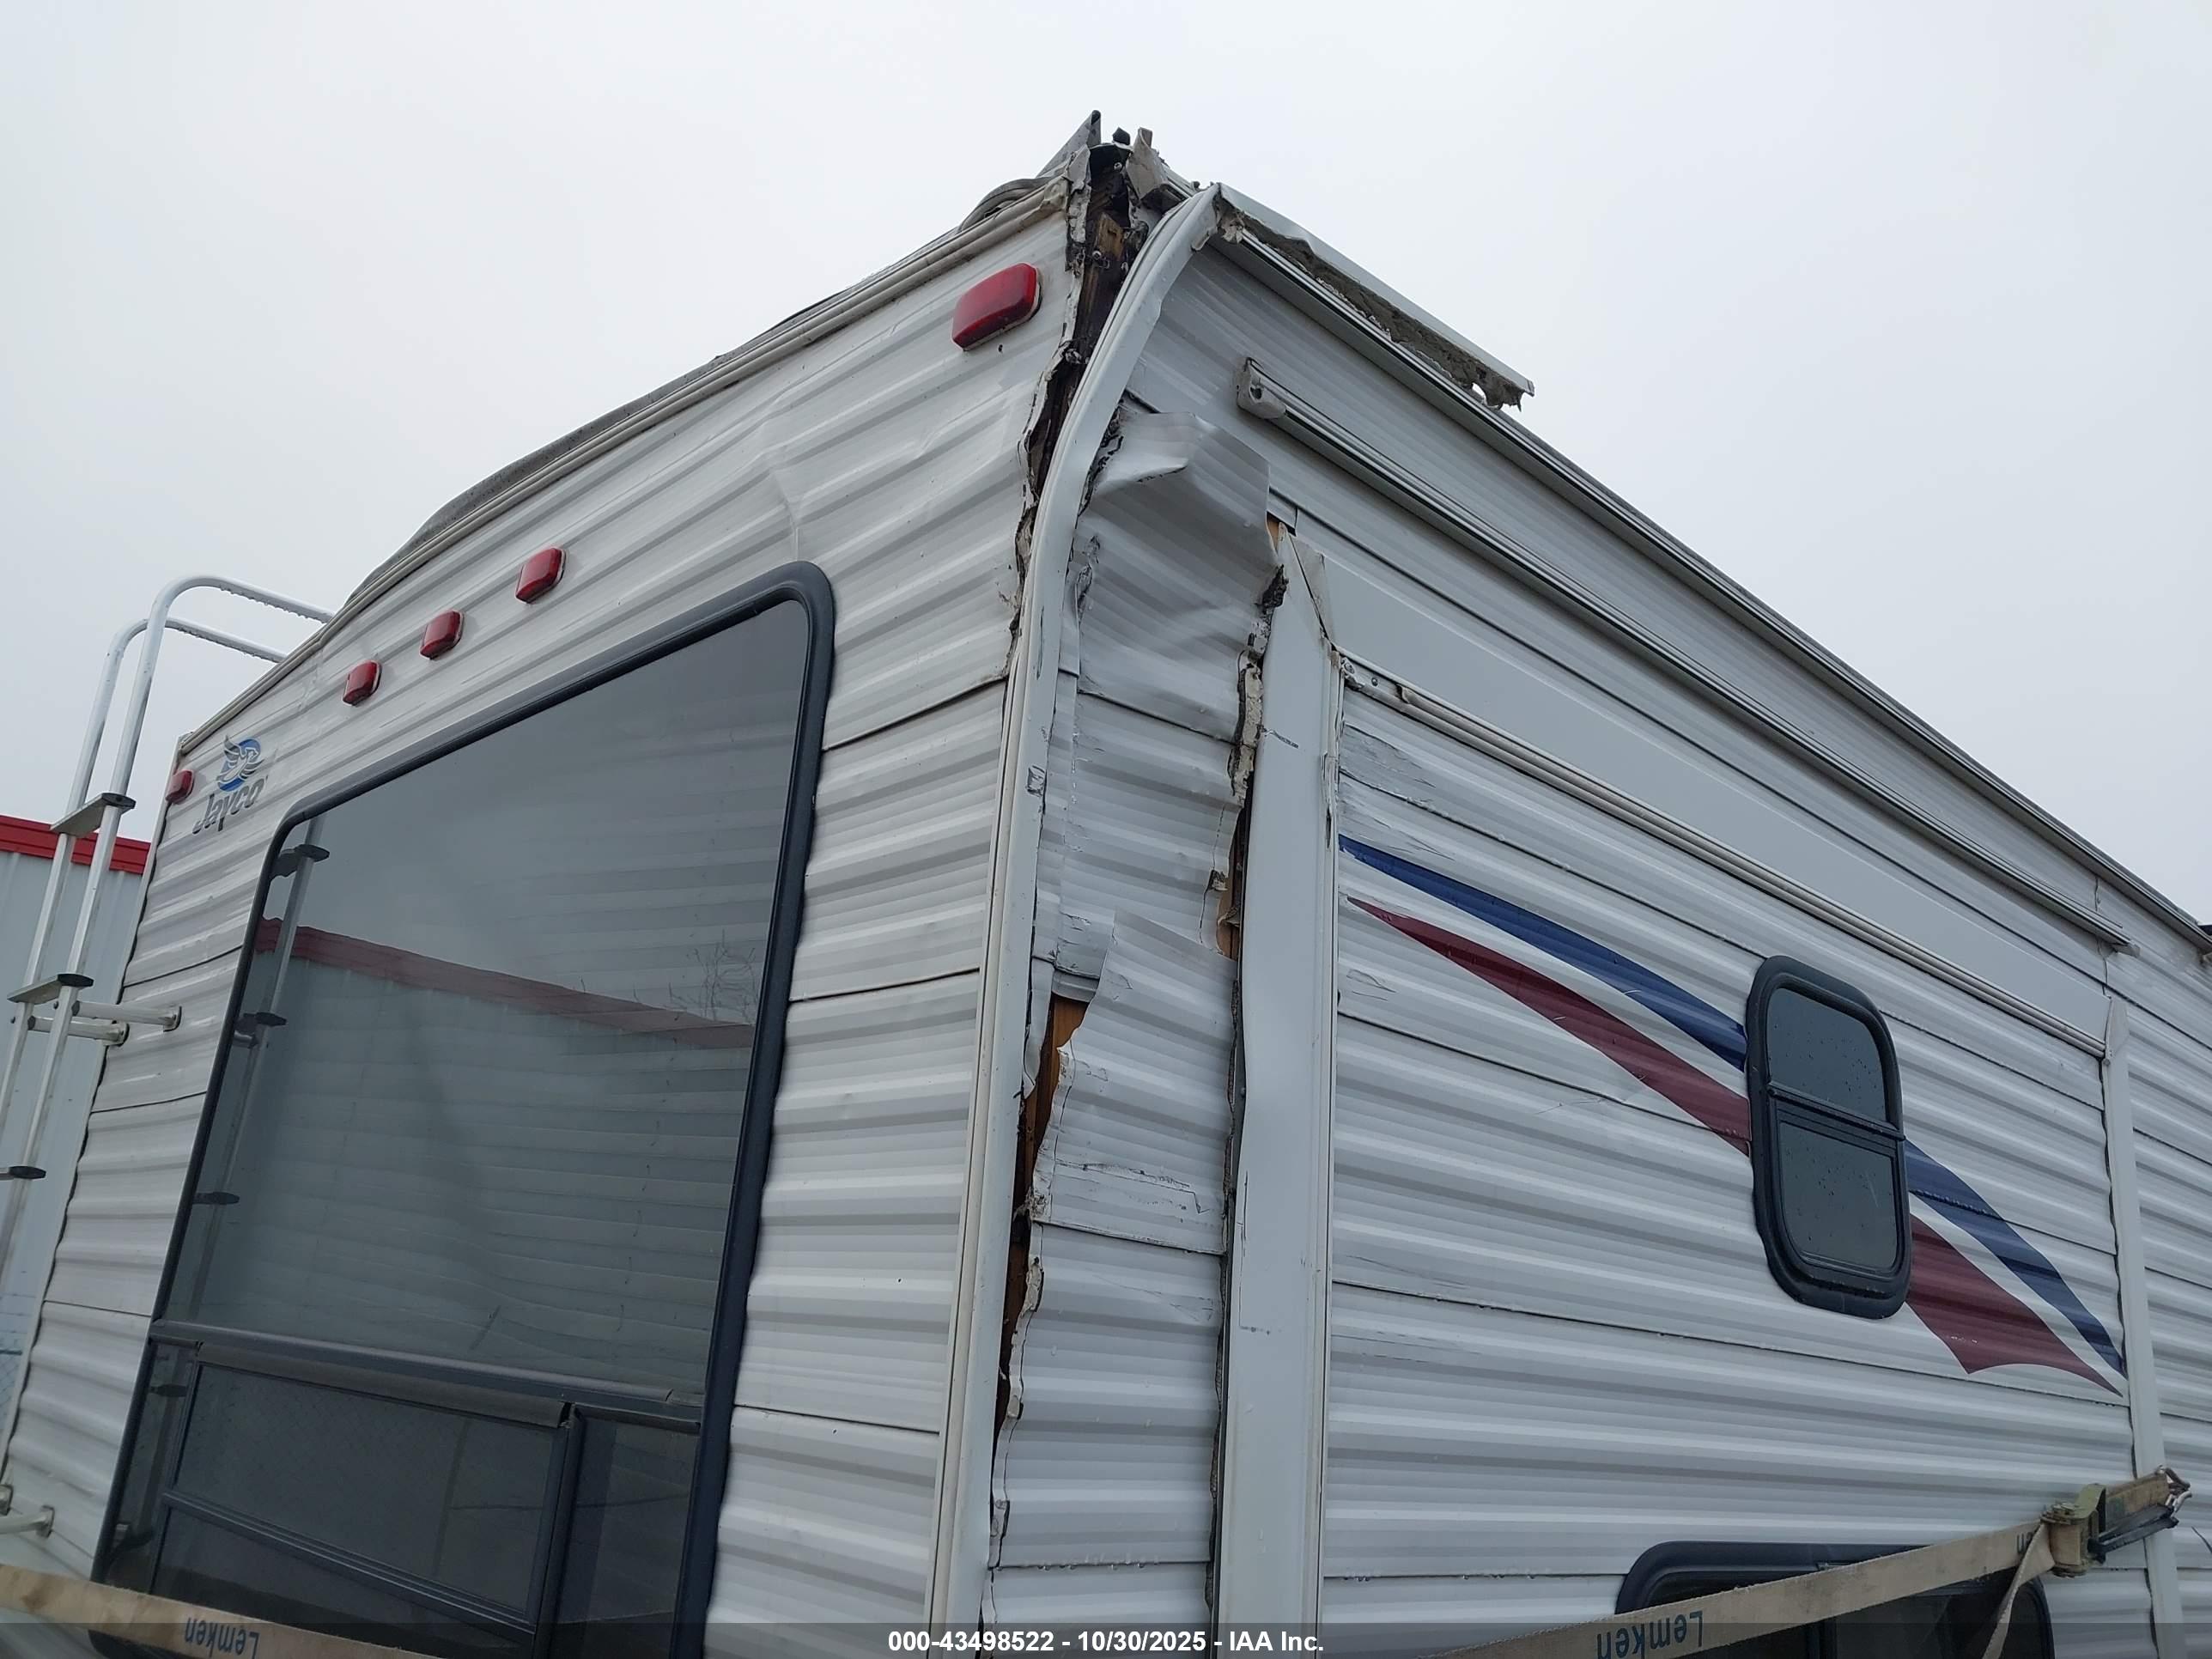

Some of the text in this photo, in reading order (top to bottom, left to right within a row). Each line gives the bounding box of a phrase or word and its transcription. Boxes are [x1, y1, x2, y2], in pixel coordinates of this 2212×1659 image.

[191, 777, 264, 835] Jayco
[185, 1617, 260, 1659] Lemken
[1595, 1610, 1704, 1659] Lemken
